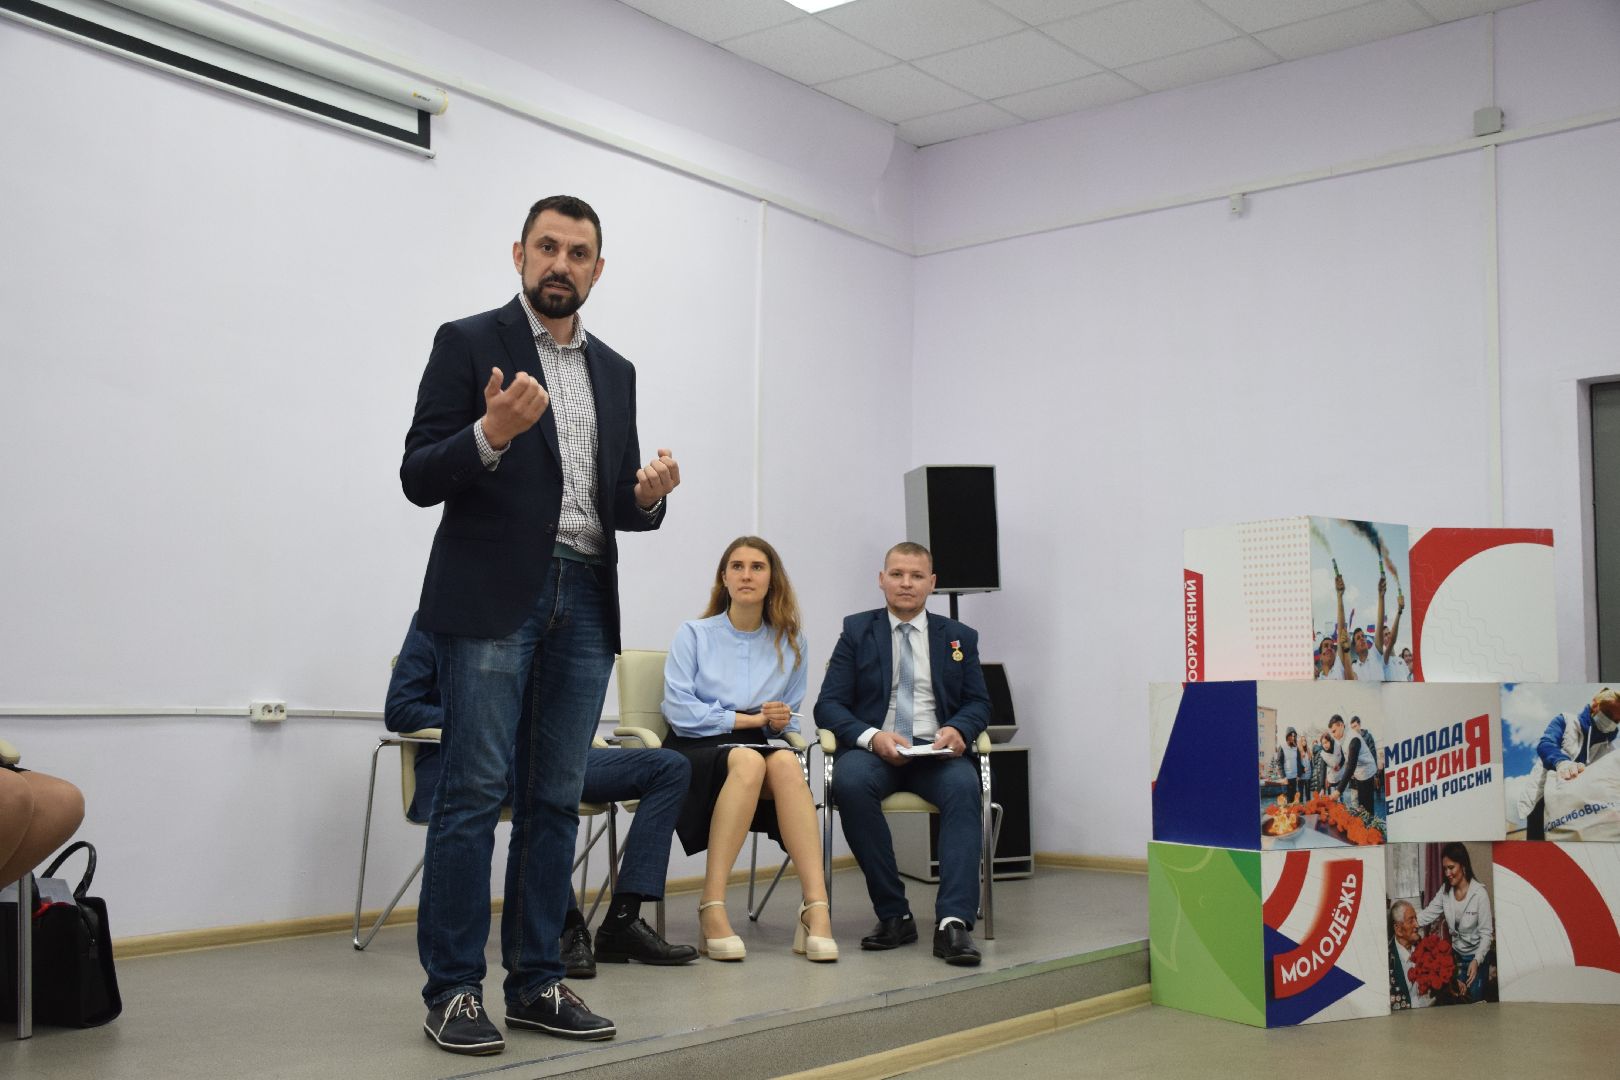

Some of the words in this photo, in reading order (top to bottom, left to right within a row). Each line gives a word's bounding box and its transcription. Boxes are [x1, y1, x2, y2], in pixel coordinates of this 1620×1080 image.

[1386, 784, 1438, 816] ЕДИНОЙ
[1442, 767, 1492, 797] РОССИИ
[1280, 873, 1357, 985] МОЛОДЁЖЬ
